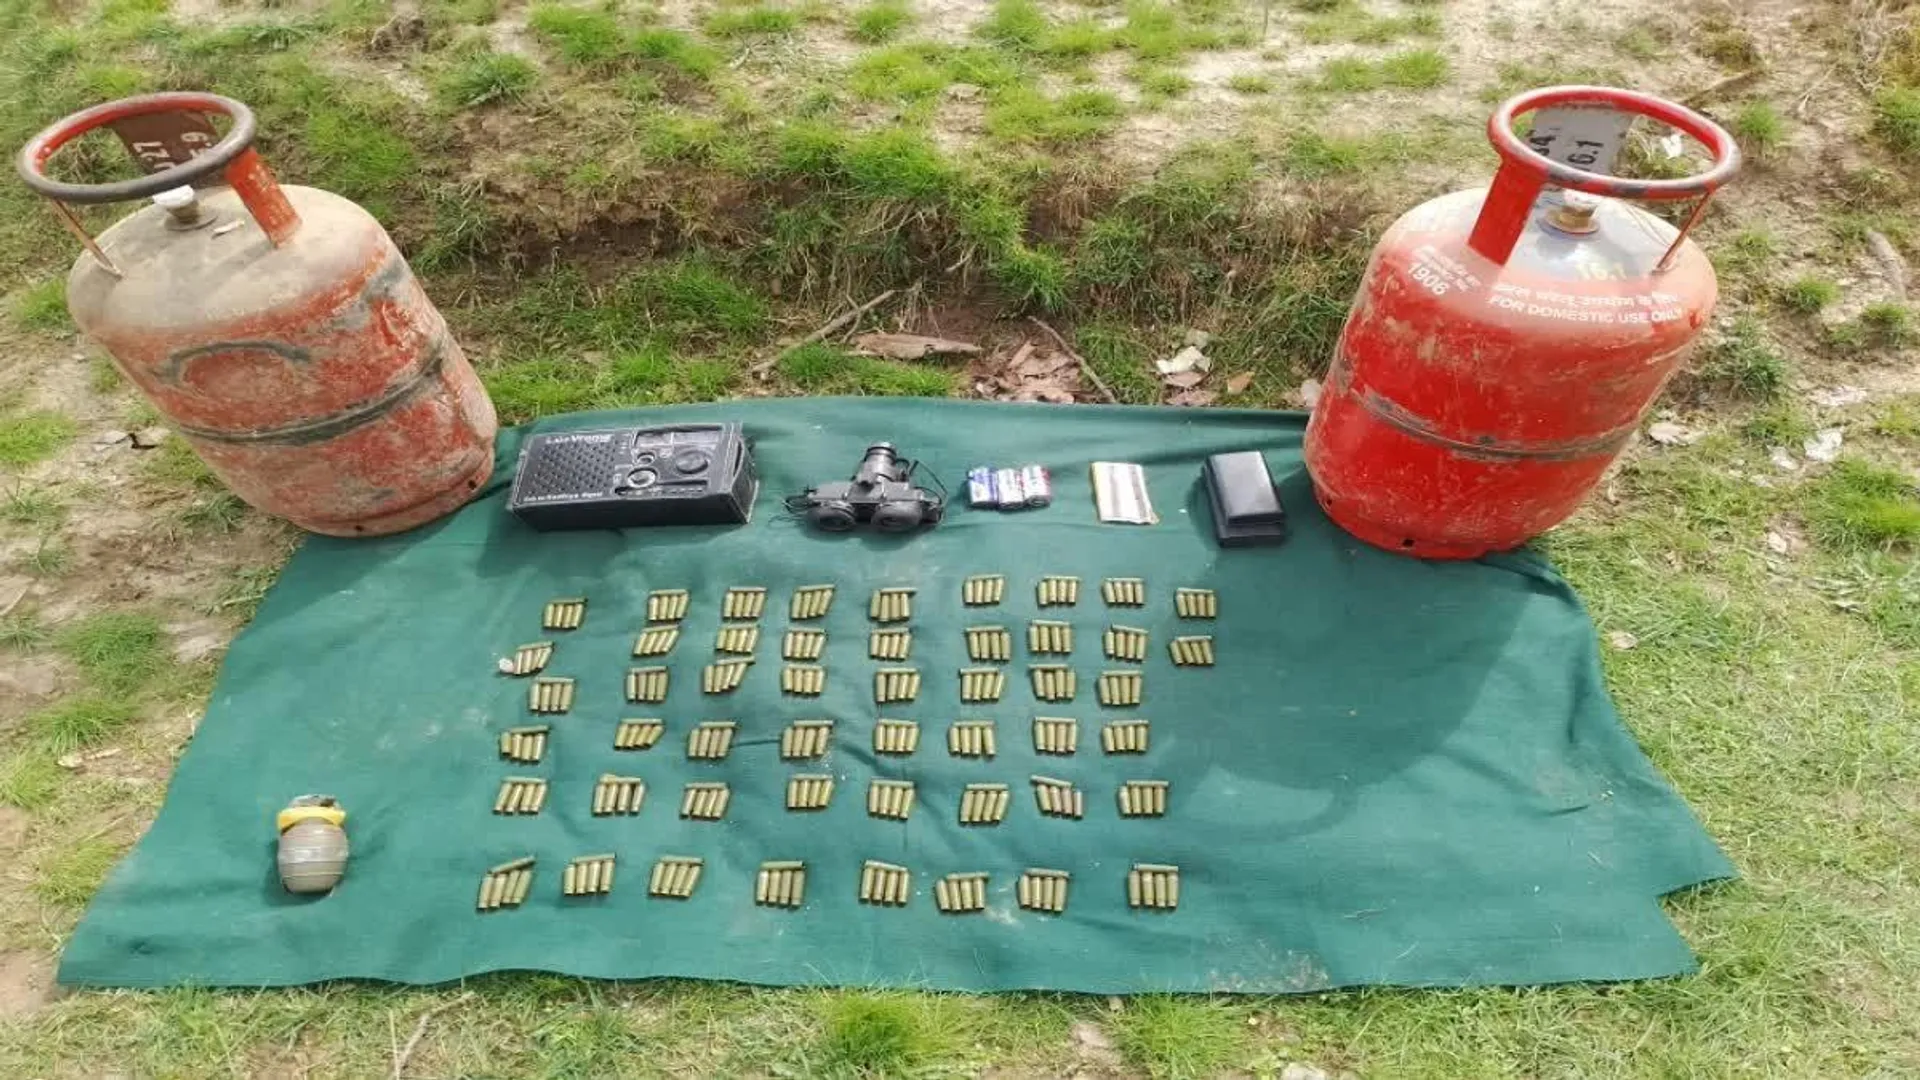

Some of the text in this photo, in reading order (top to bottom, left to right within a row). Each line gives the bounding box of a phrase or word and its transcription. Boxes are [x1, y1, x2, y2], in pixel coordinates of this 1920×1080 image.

[1407, 261, 1449, 296] 1906
[1488, 295, 1525, 312] FOR
[1527, 303, 1614, 324] DOMESTIC
[1618, 311, 1650, 324] USE
[1651, 307, 1684, 323] ONLY
